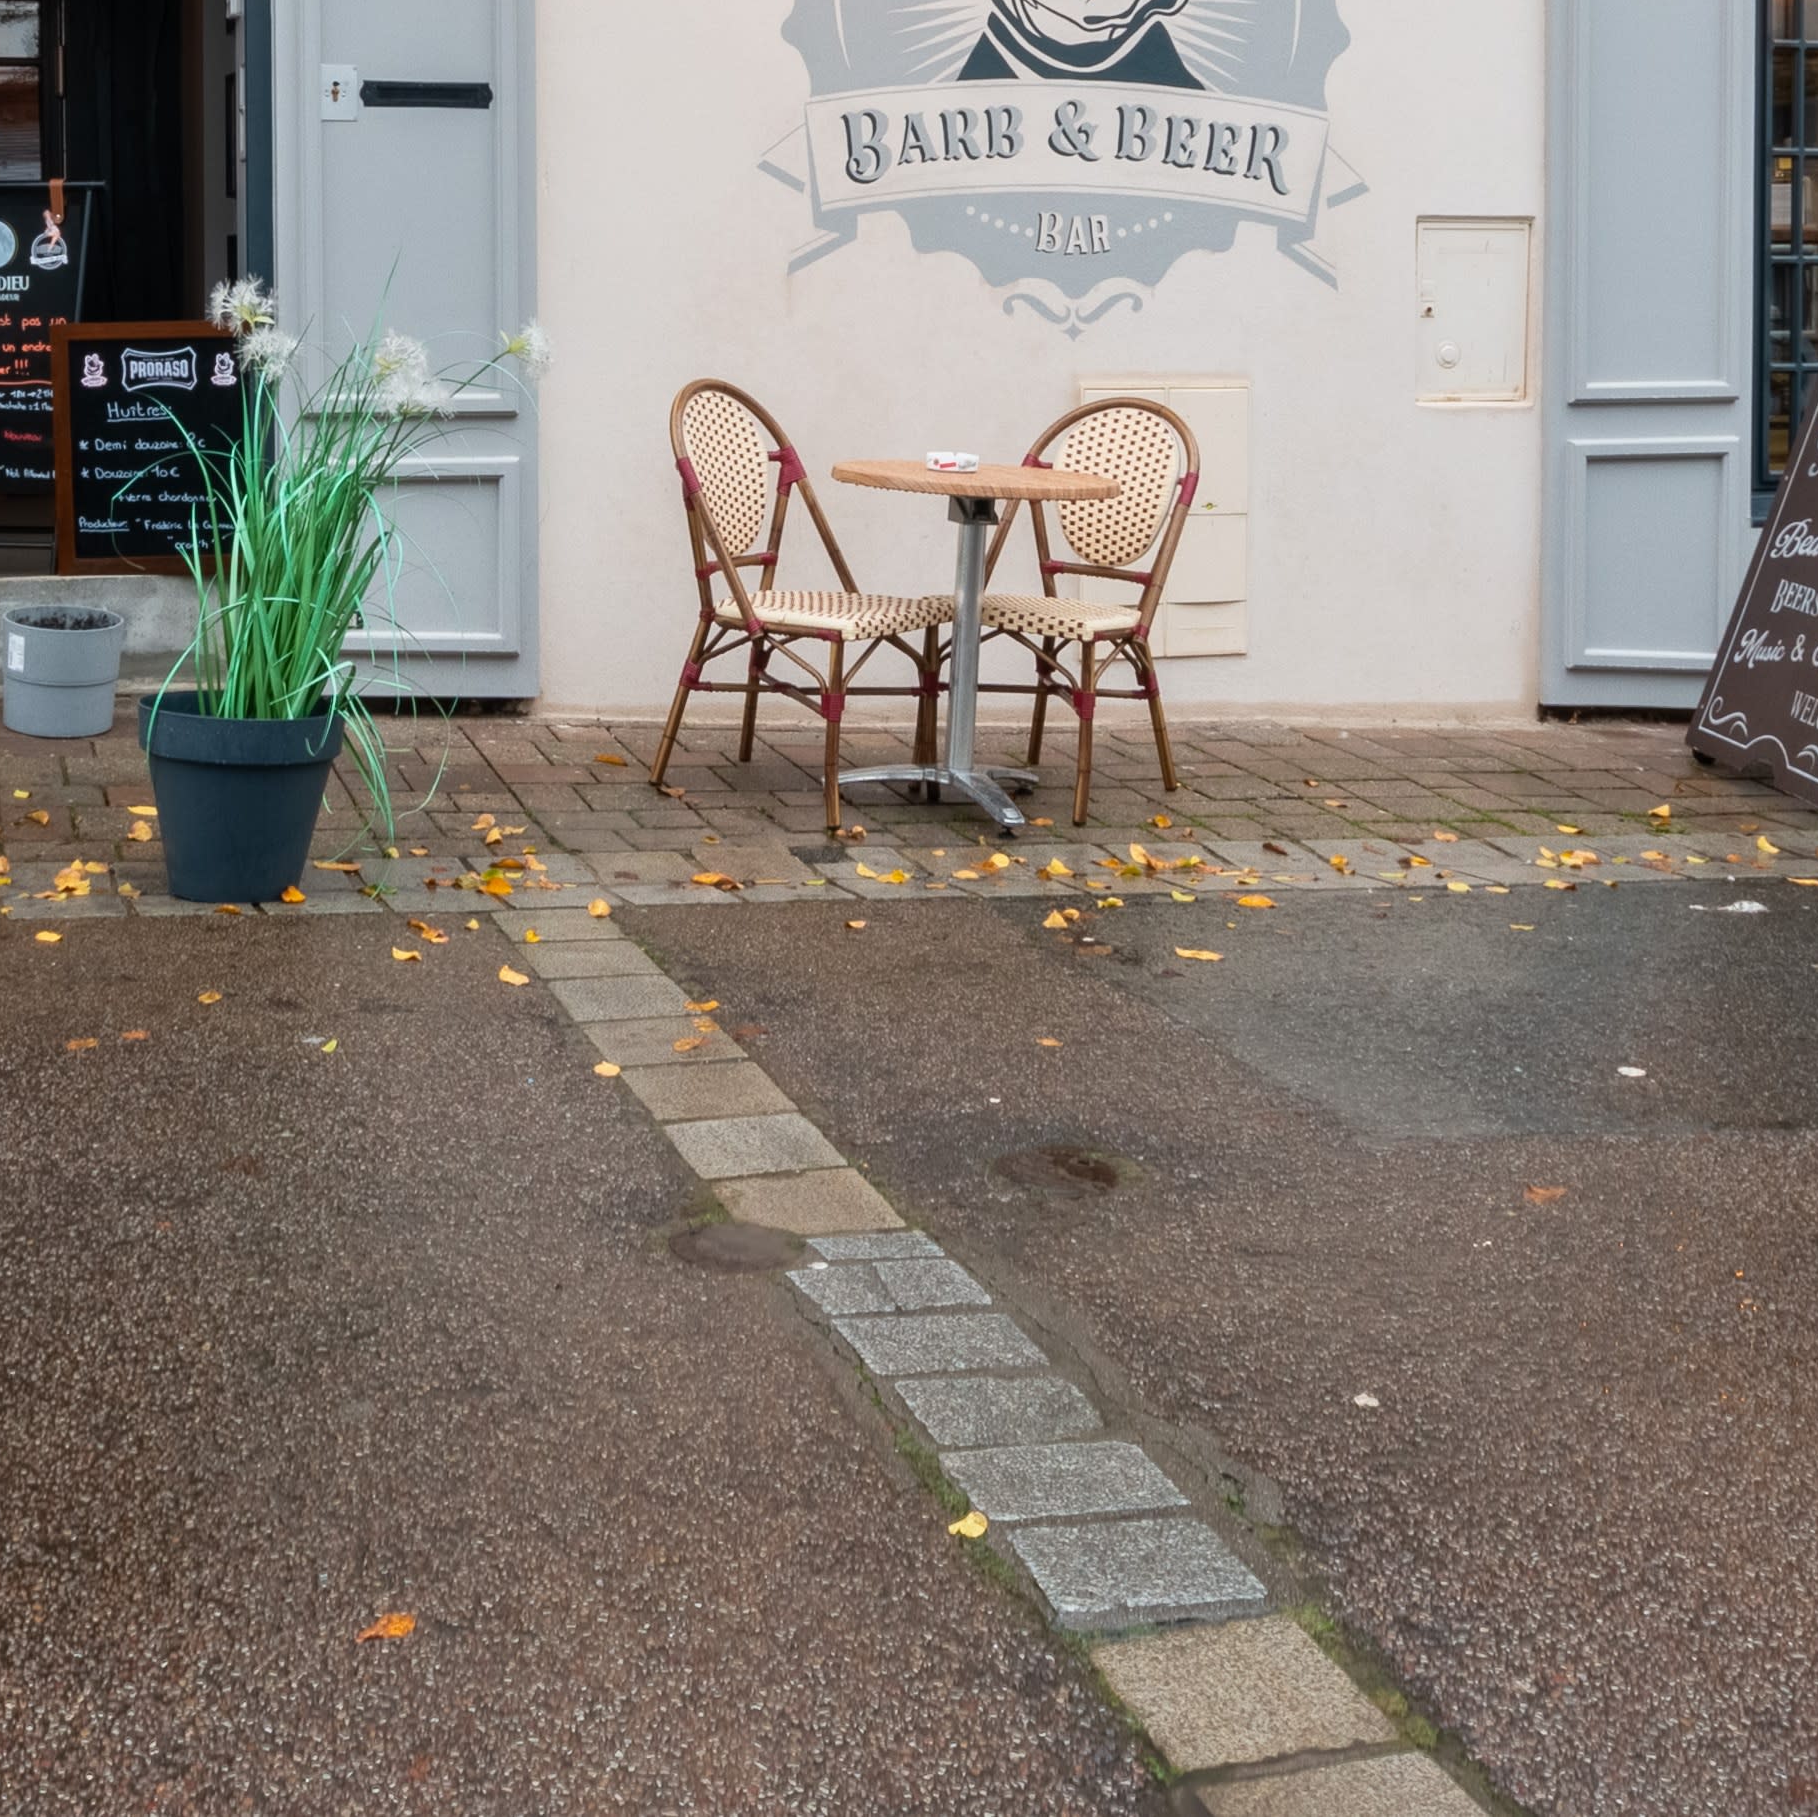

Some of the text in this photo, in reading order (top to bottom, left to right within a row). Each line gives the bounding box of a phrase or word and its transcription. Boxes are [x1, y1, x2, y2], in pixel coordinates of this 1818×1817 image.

[840, 98, 1294, 196] BARB & BEER
[1035, 210, 1112, 256] BAR
[21, 317, 42, 331] pas
[2, 343, 16, 353] un
[129, 359, 189, 380] PRORASO
[94, 438, 127, 451] Demi
[1733, 628, 1785, 670] Music
[1789, 635, 1805, 661] &
